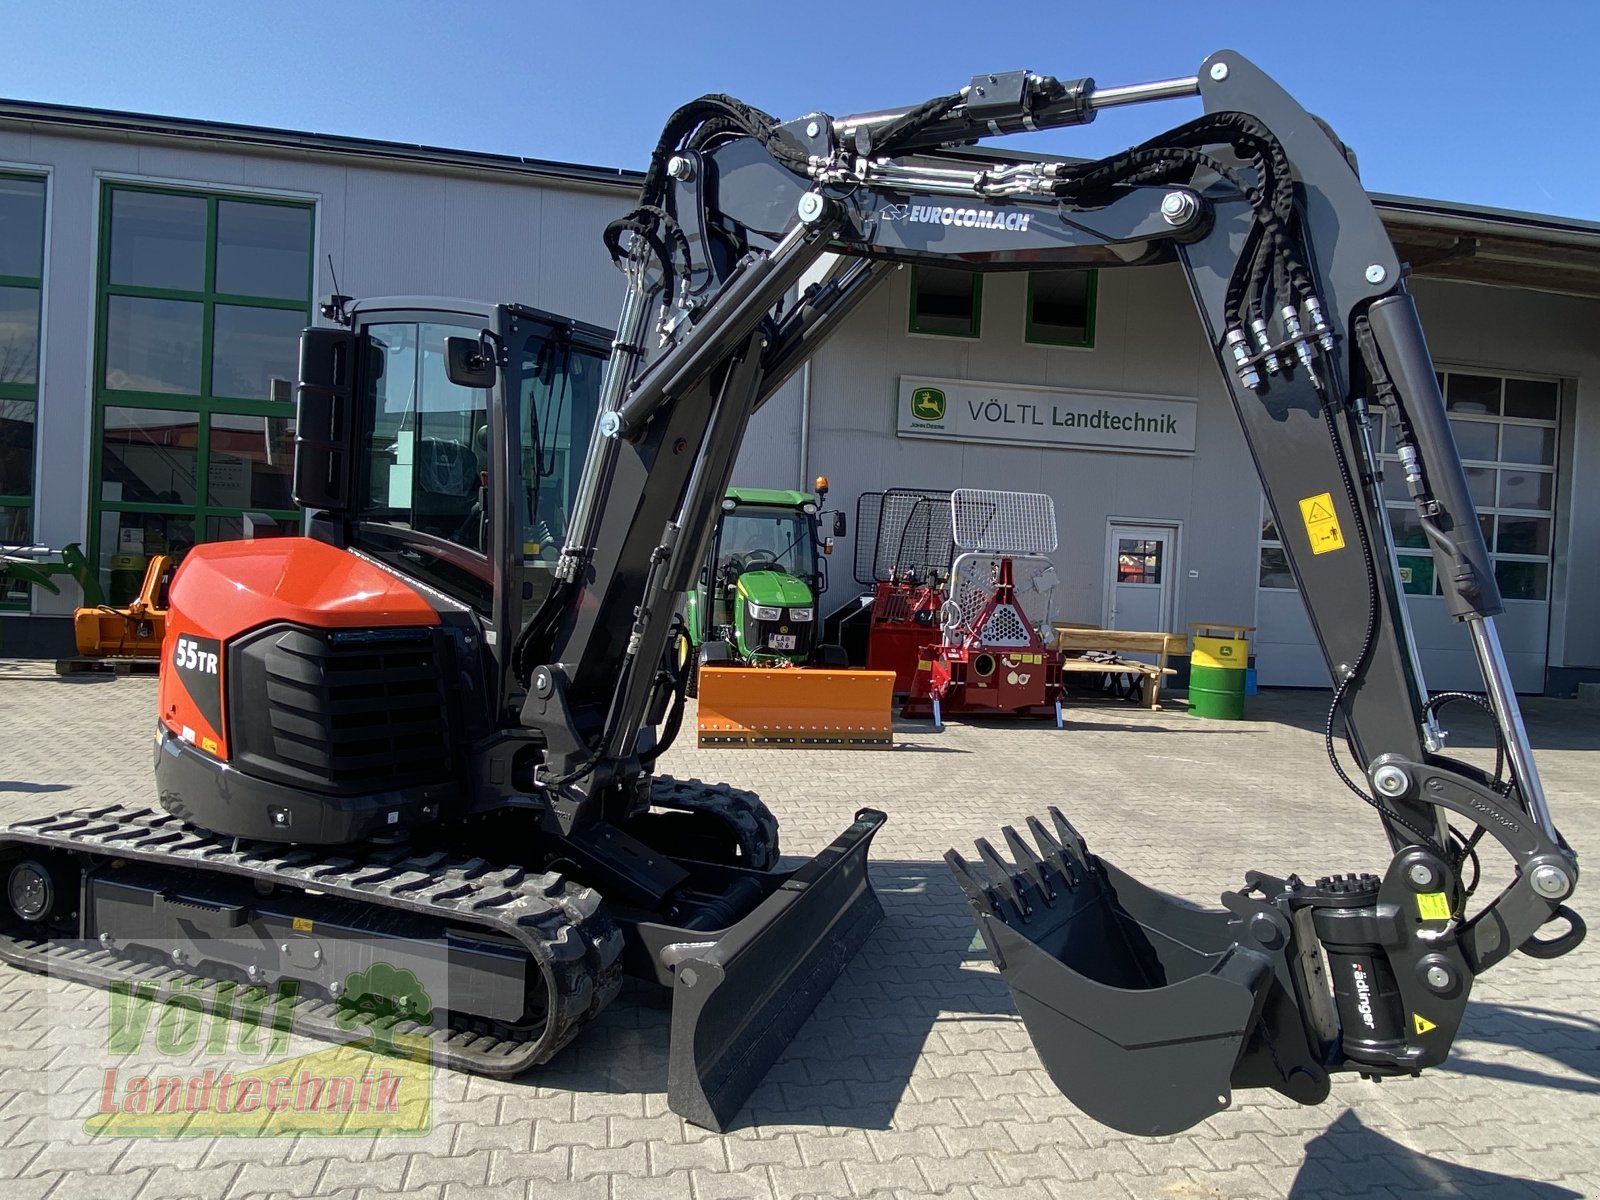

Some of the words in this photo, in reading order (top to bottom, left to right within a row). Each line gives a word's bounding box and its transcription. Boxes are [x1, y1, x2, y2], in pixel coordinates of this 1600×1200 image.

[910, 205, 1030, 231] EUROCOMACH
[968, 399, 1043, 425] VÖLTL
[1052, 406, 1177, 434] Landtechnik
[176, 638, 218, 674] 55TR
